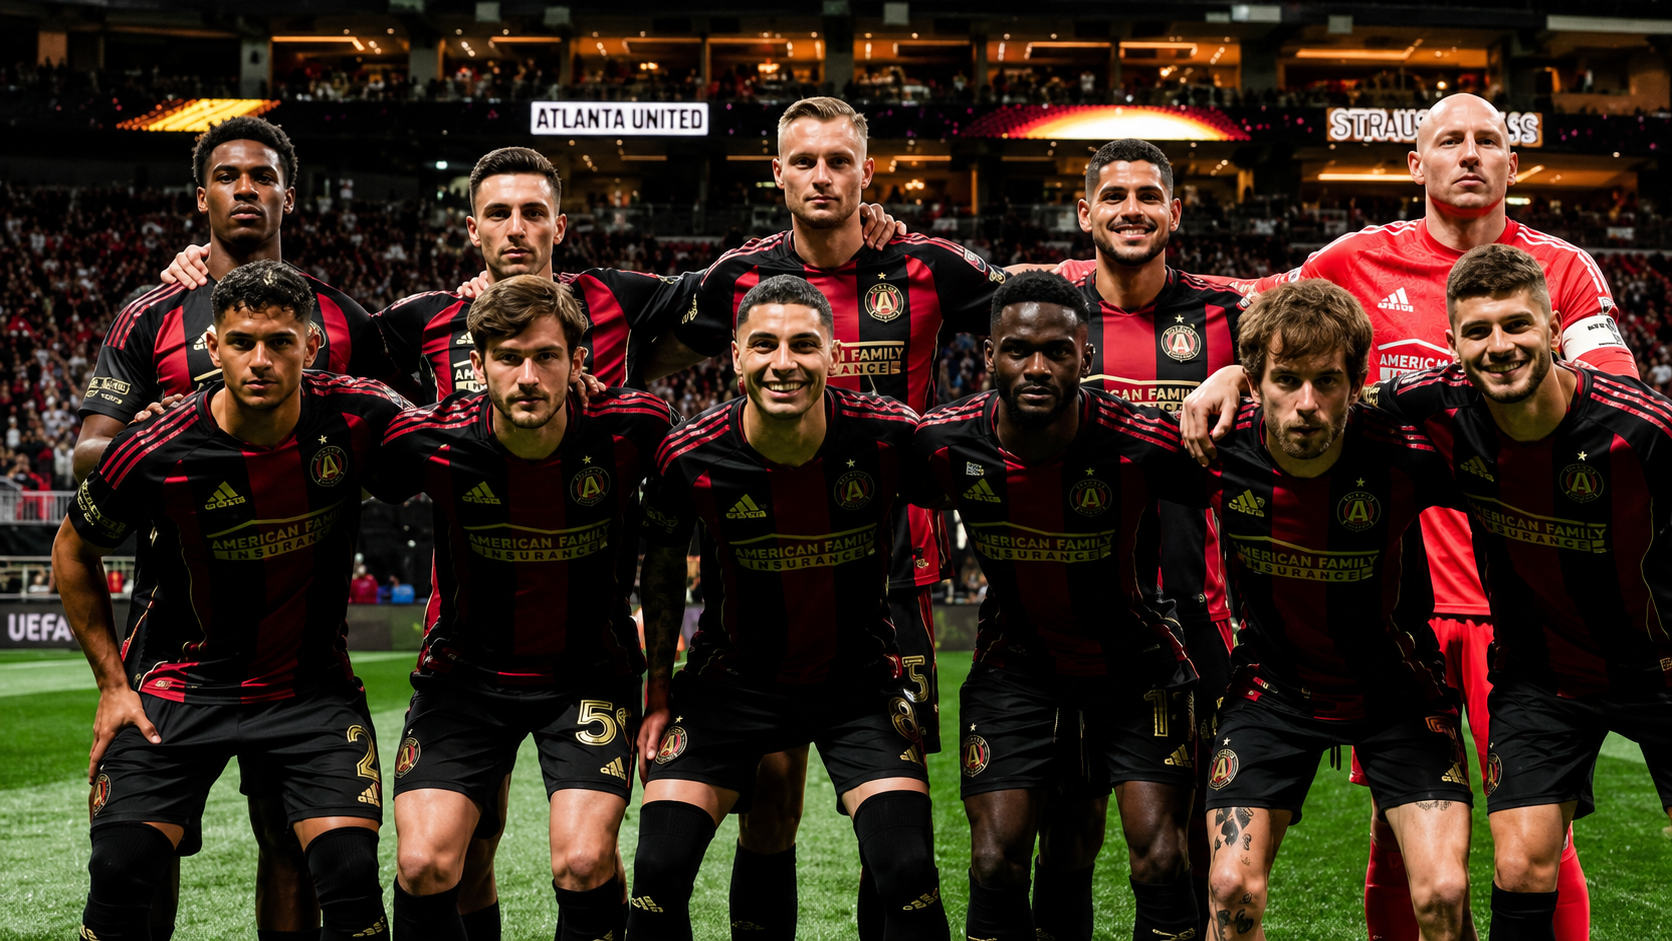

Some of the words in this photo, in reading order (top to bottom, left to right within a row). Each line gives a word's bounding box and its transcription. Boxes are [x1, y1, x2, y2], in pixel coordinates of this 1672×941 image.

[537, 108, 625, 129] ATLANTA
[632, 108, 703, 129] UNITED
[851, 347, 904, 361] FAMILY
[1148, 387, 1195, 401] FAMI
[211, 523, 299, 551] AMERICAN
[468, 532, 555, 550] AMERICAN
[559, 521, 610, 547] FAMILY
[970, 529, 1055, 550] AMERICAN
[1056, 534, 1114, 550] FAMILY
[1545, 522, 1607, 540] FAMILY
[482, 543, 597, 561] INSURANCE
[734, 542, 819, 559] AMERICAN
[824, 528, 878, 553] FAMILY
[983, 544, 1097, 561] INSURANCE
[749, 547, 863, 570] INSURANCE
[1319, 555, 1378, 569] FAMILY
[8, 613, 73, 642] UEFA
[901, 654, 929, 703] 5
[575, 698, 617, 747] 5
[346, 724, 380, 784] 2
